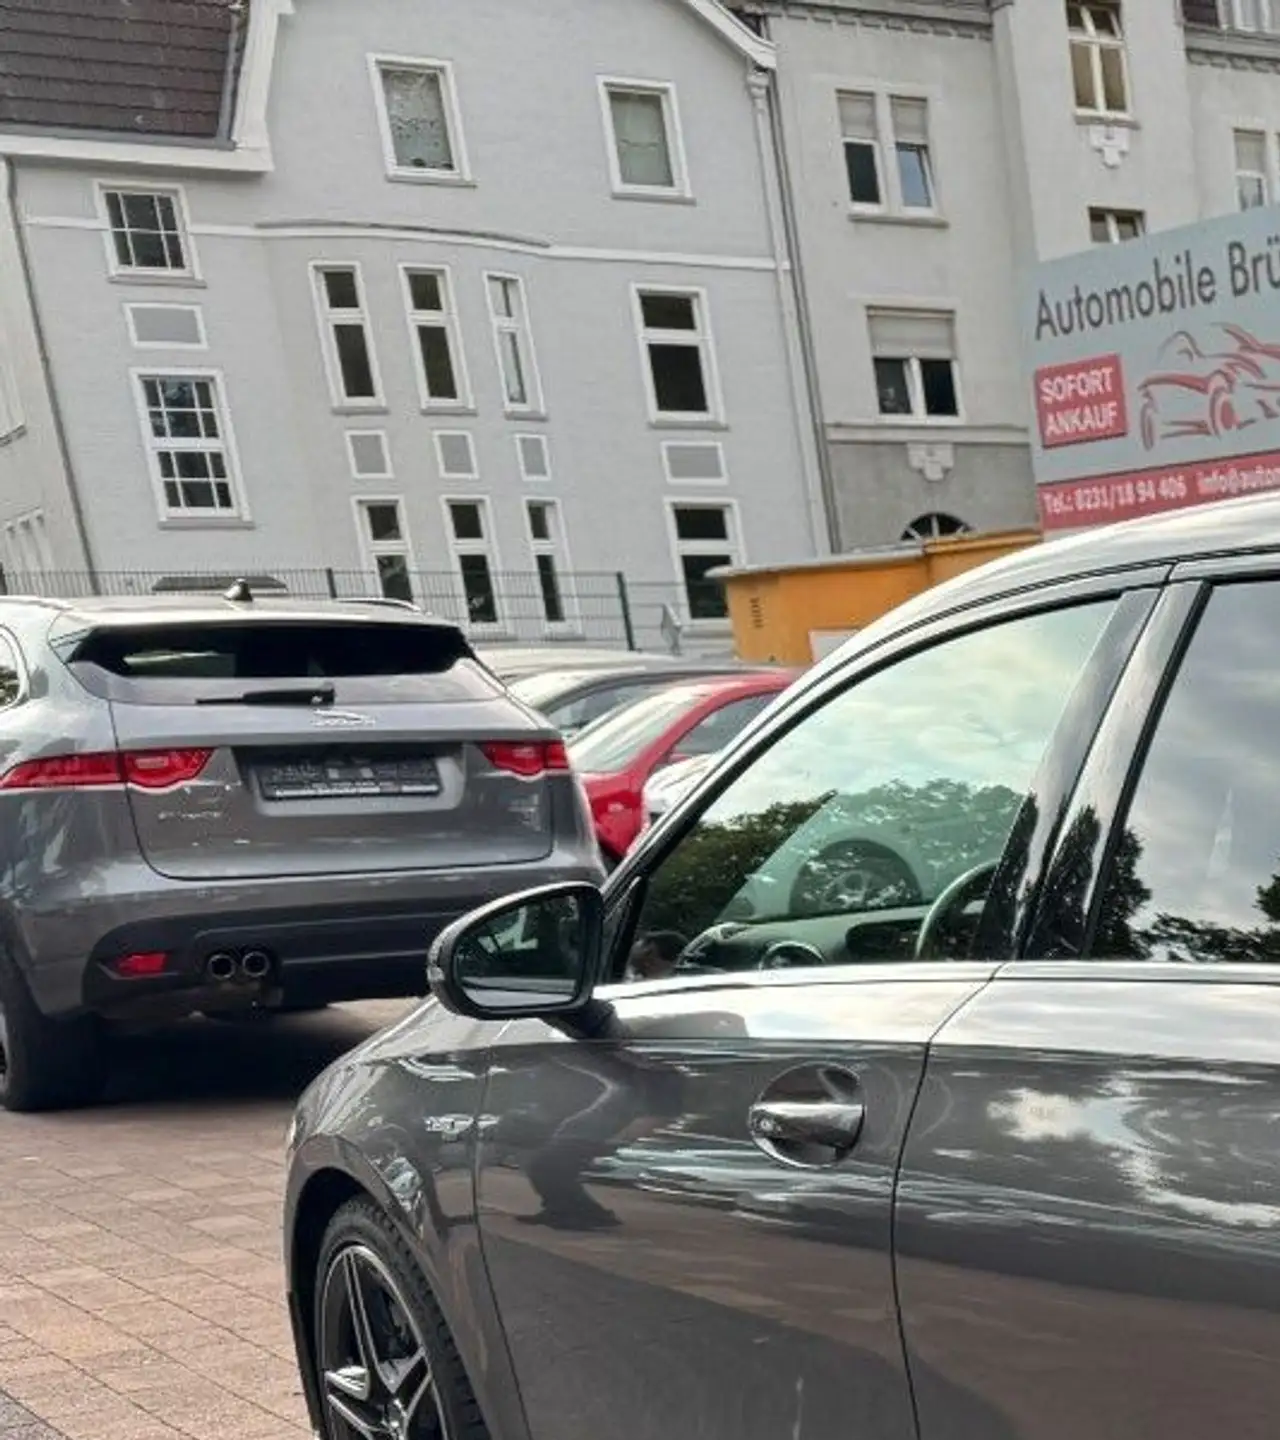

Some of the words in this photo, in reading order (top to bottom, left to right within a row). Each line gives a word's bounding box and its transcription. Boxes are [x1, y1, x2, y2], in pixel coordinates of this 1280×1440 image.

[1035, 250, 1215, 341] Automobile
[1040, 366, 1113, 405] SOFORT
[1045, 401, 1117, 437] ANKAUF
